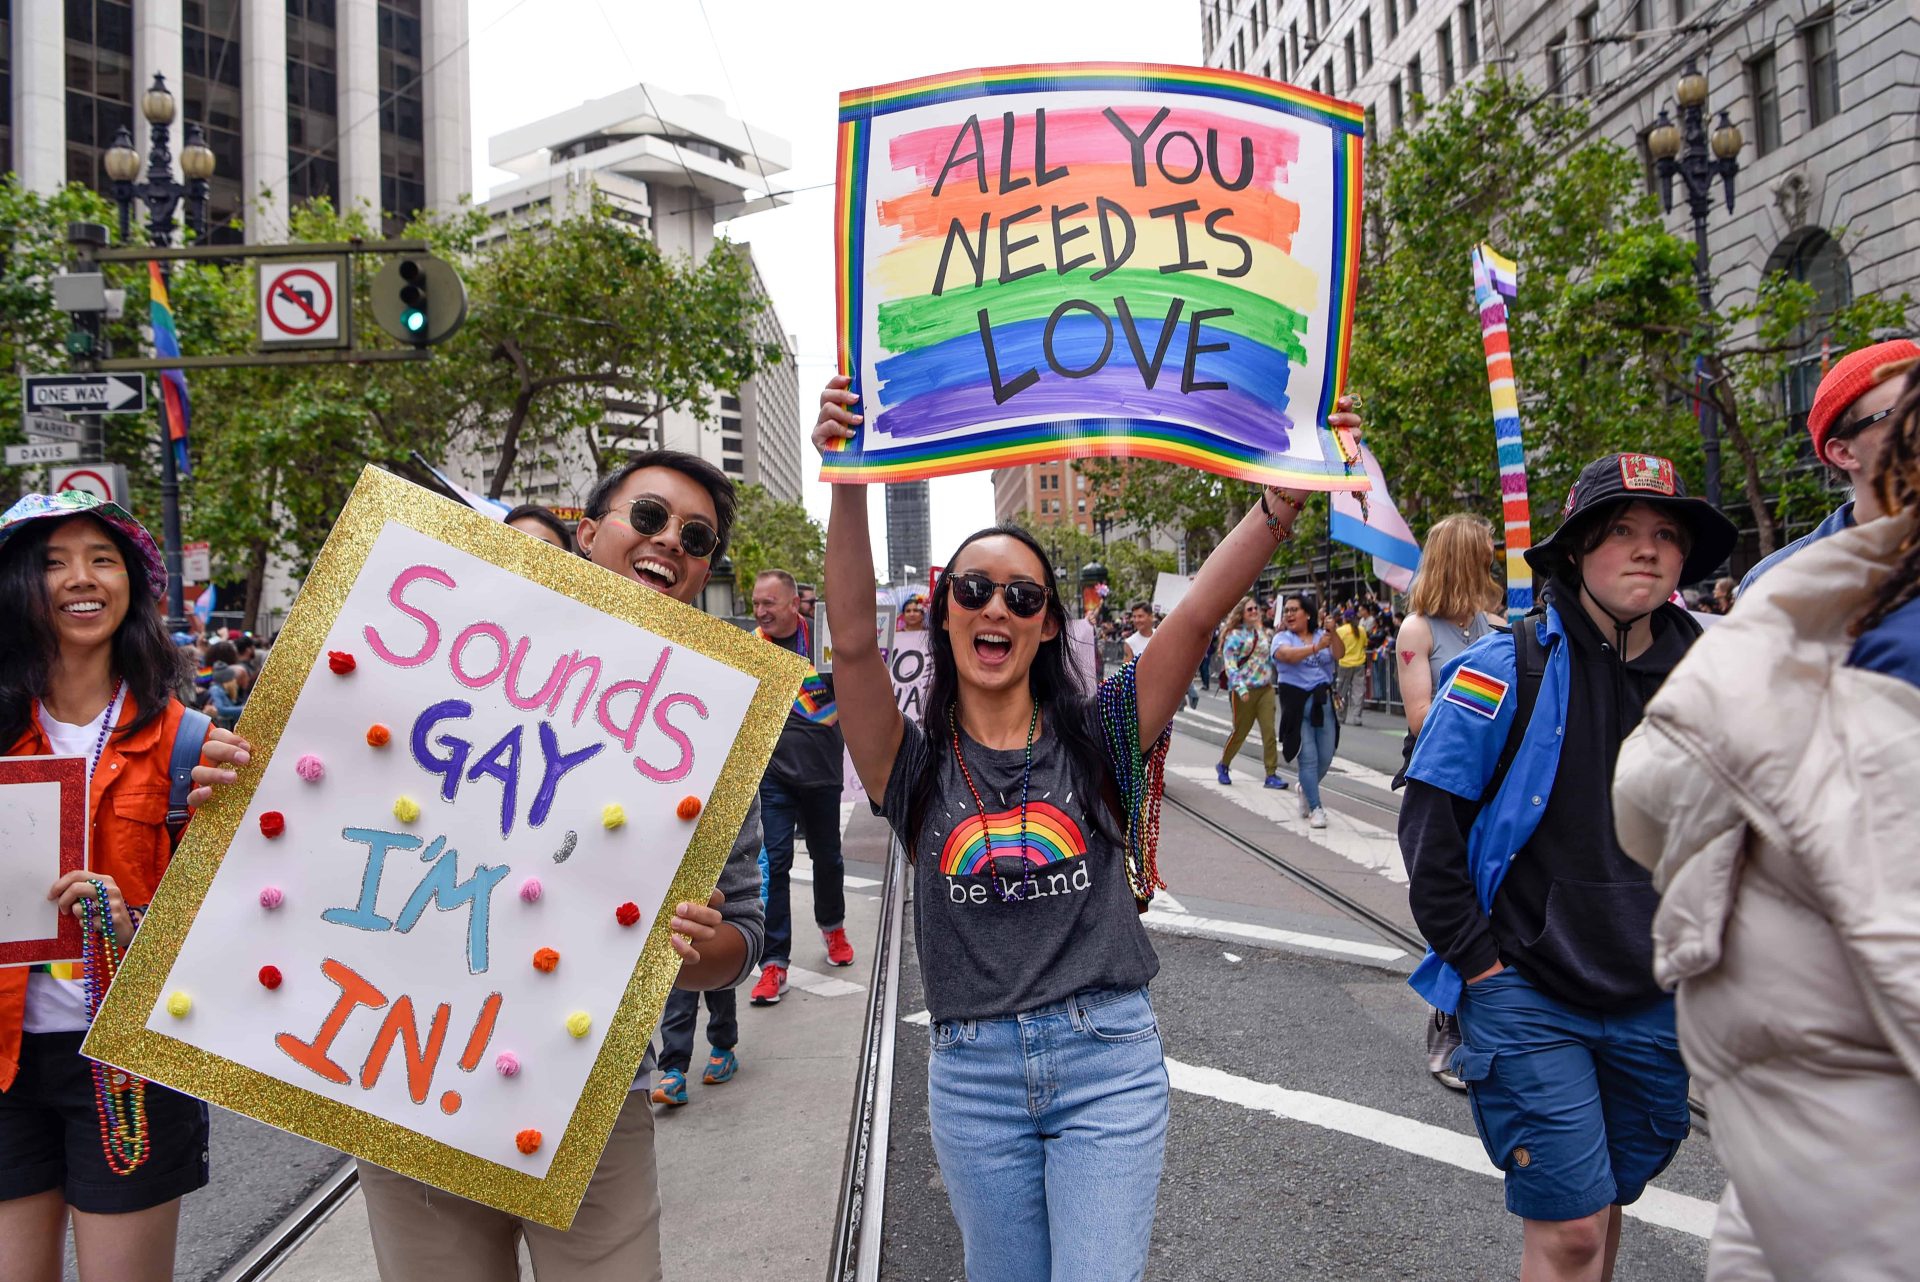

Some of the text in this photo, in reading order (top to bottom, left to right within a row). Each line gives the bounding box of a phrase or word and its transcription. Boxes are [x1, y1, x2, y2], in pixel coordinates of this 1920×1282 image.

[932, 106, 1254, 196] ALL YOU
[932, 196, 1253, 295] NEED IS
[37, 386, 107, 402] ONE WAY
[977, 296, 1234, 405] LOVE
[20, 446, 62, 459] DAVIS
[34, 420, 76, 436] MARKET
[362, 563, 710, 785] Sounds
[320, 826, 511, 975] I'M
[946, 860, 1092, 904] be kind
[274, 956, 503, 1116] IN!
